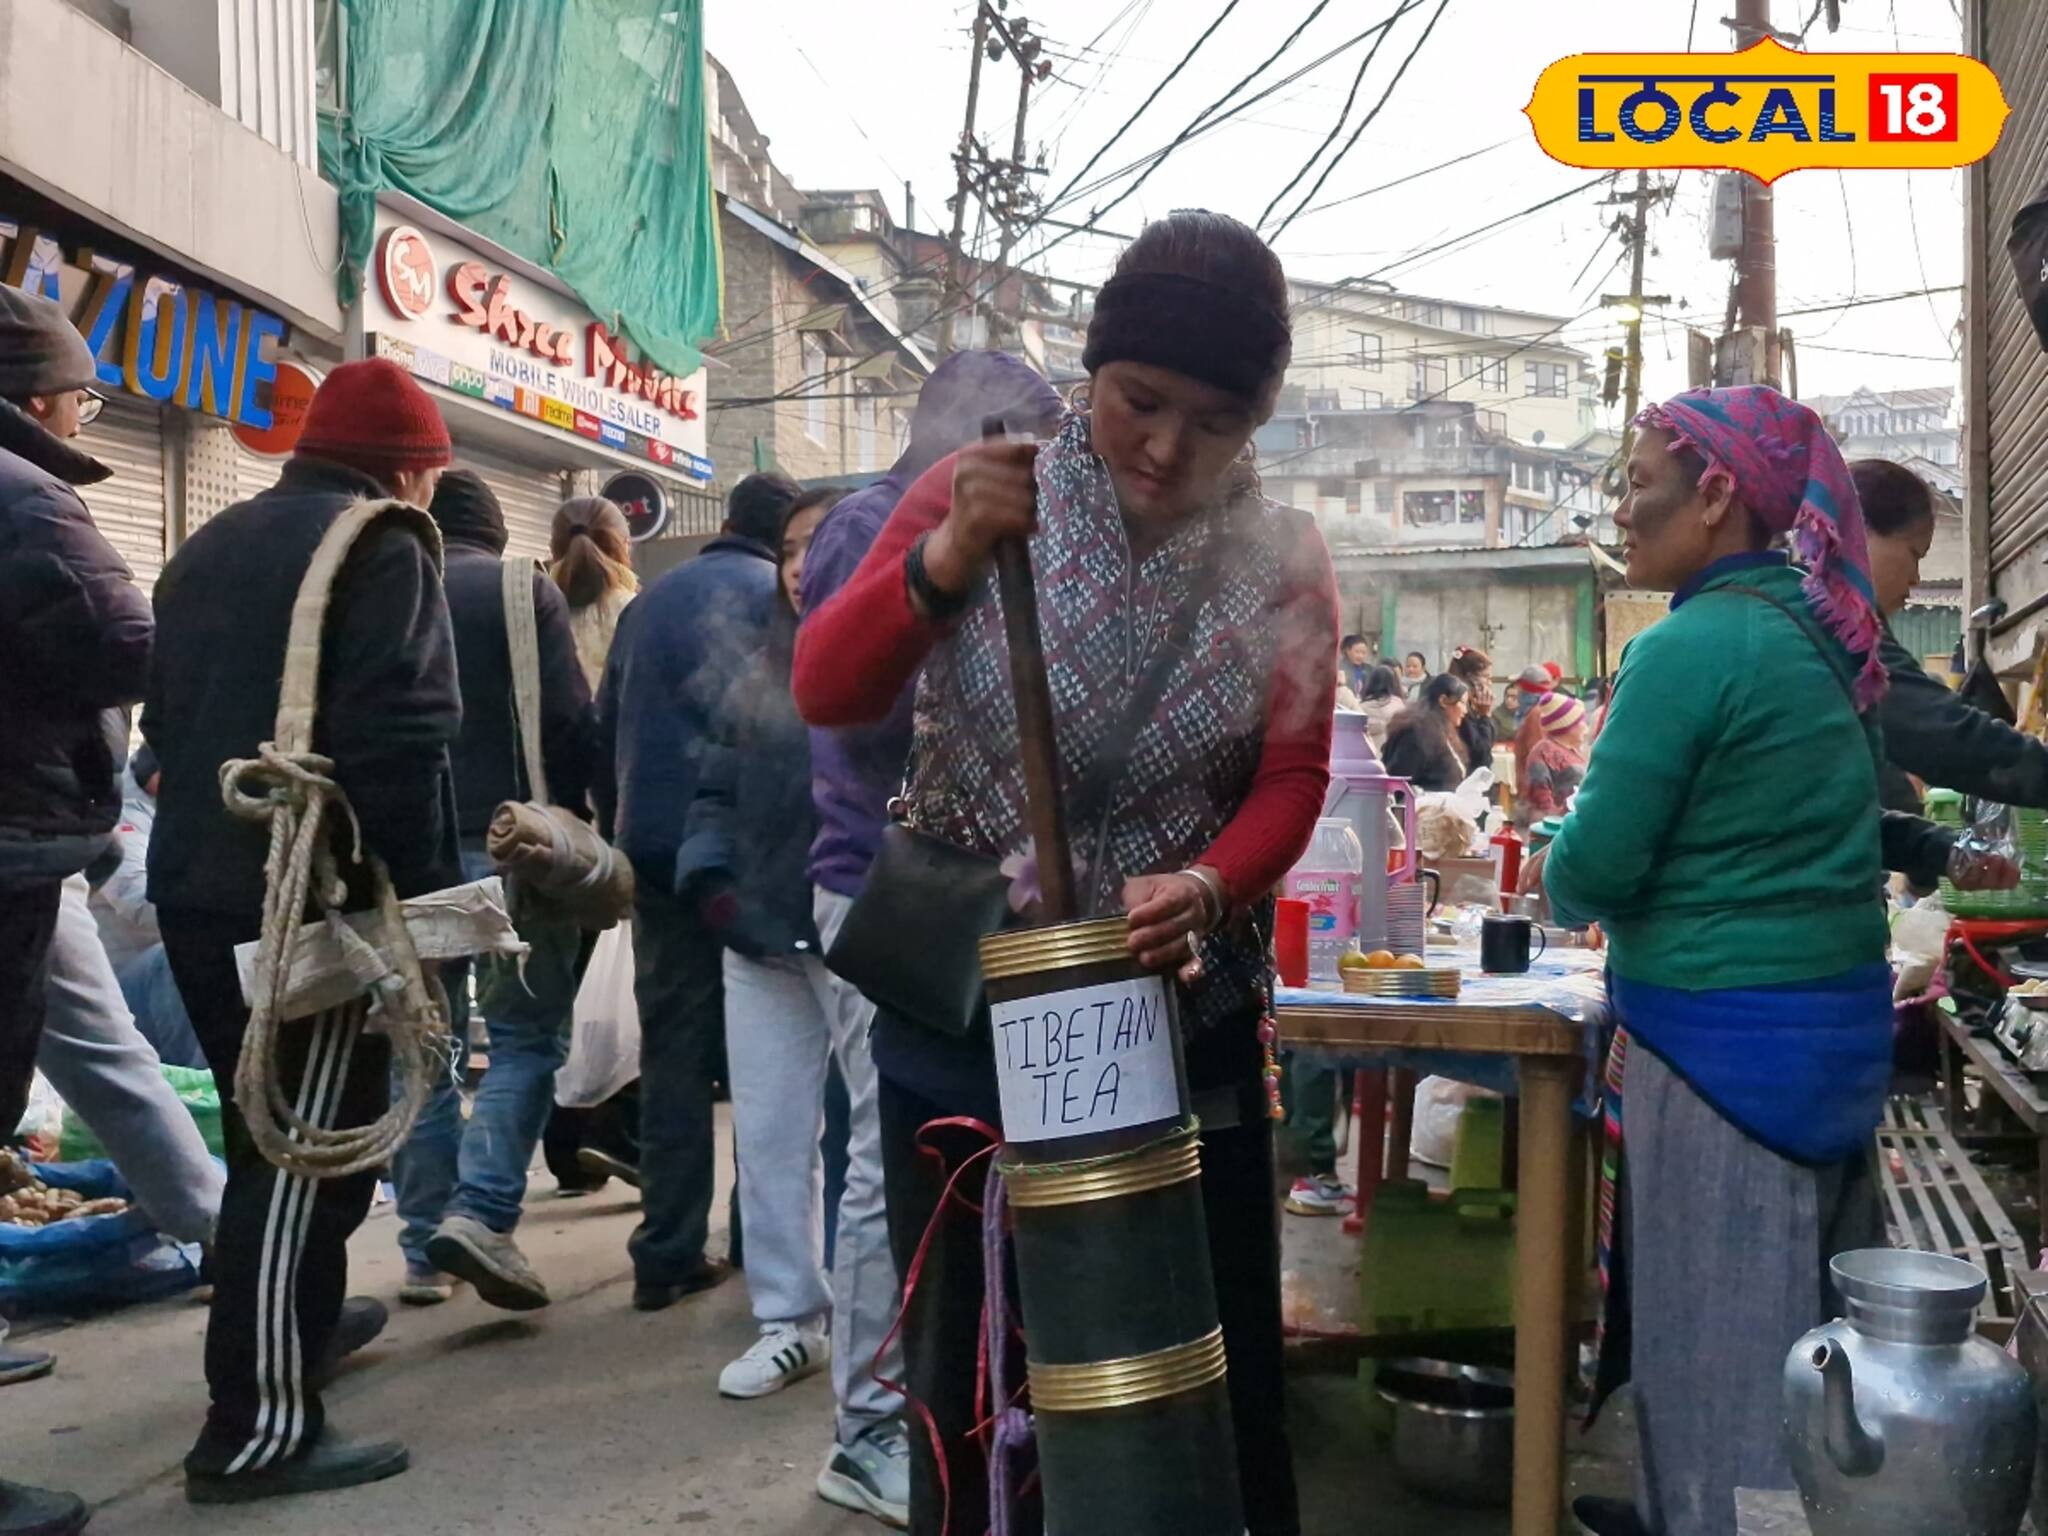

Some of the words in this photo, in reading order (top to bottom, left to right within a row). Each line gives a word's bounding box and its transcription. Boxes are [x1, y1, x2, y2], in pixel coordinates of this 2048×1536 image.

[448, 261, 573, 366] Shree
[489, 347, 556, 395] MOBILE
[561, 378, 662, 437] WHOLESALER
[998, 994, 1159, 1070] TIBETAN
[1032, 1062, 1121, 1126] TEA
